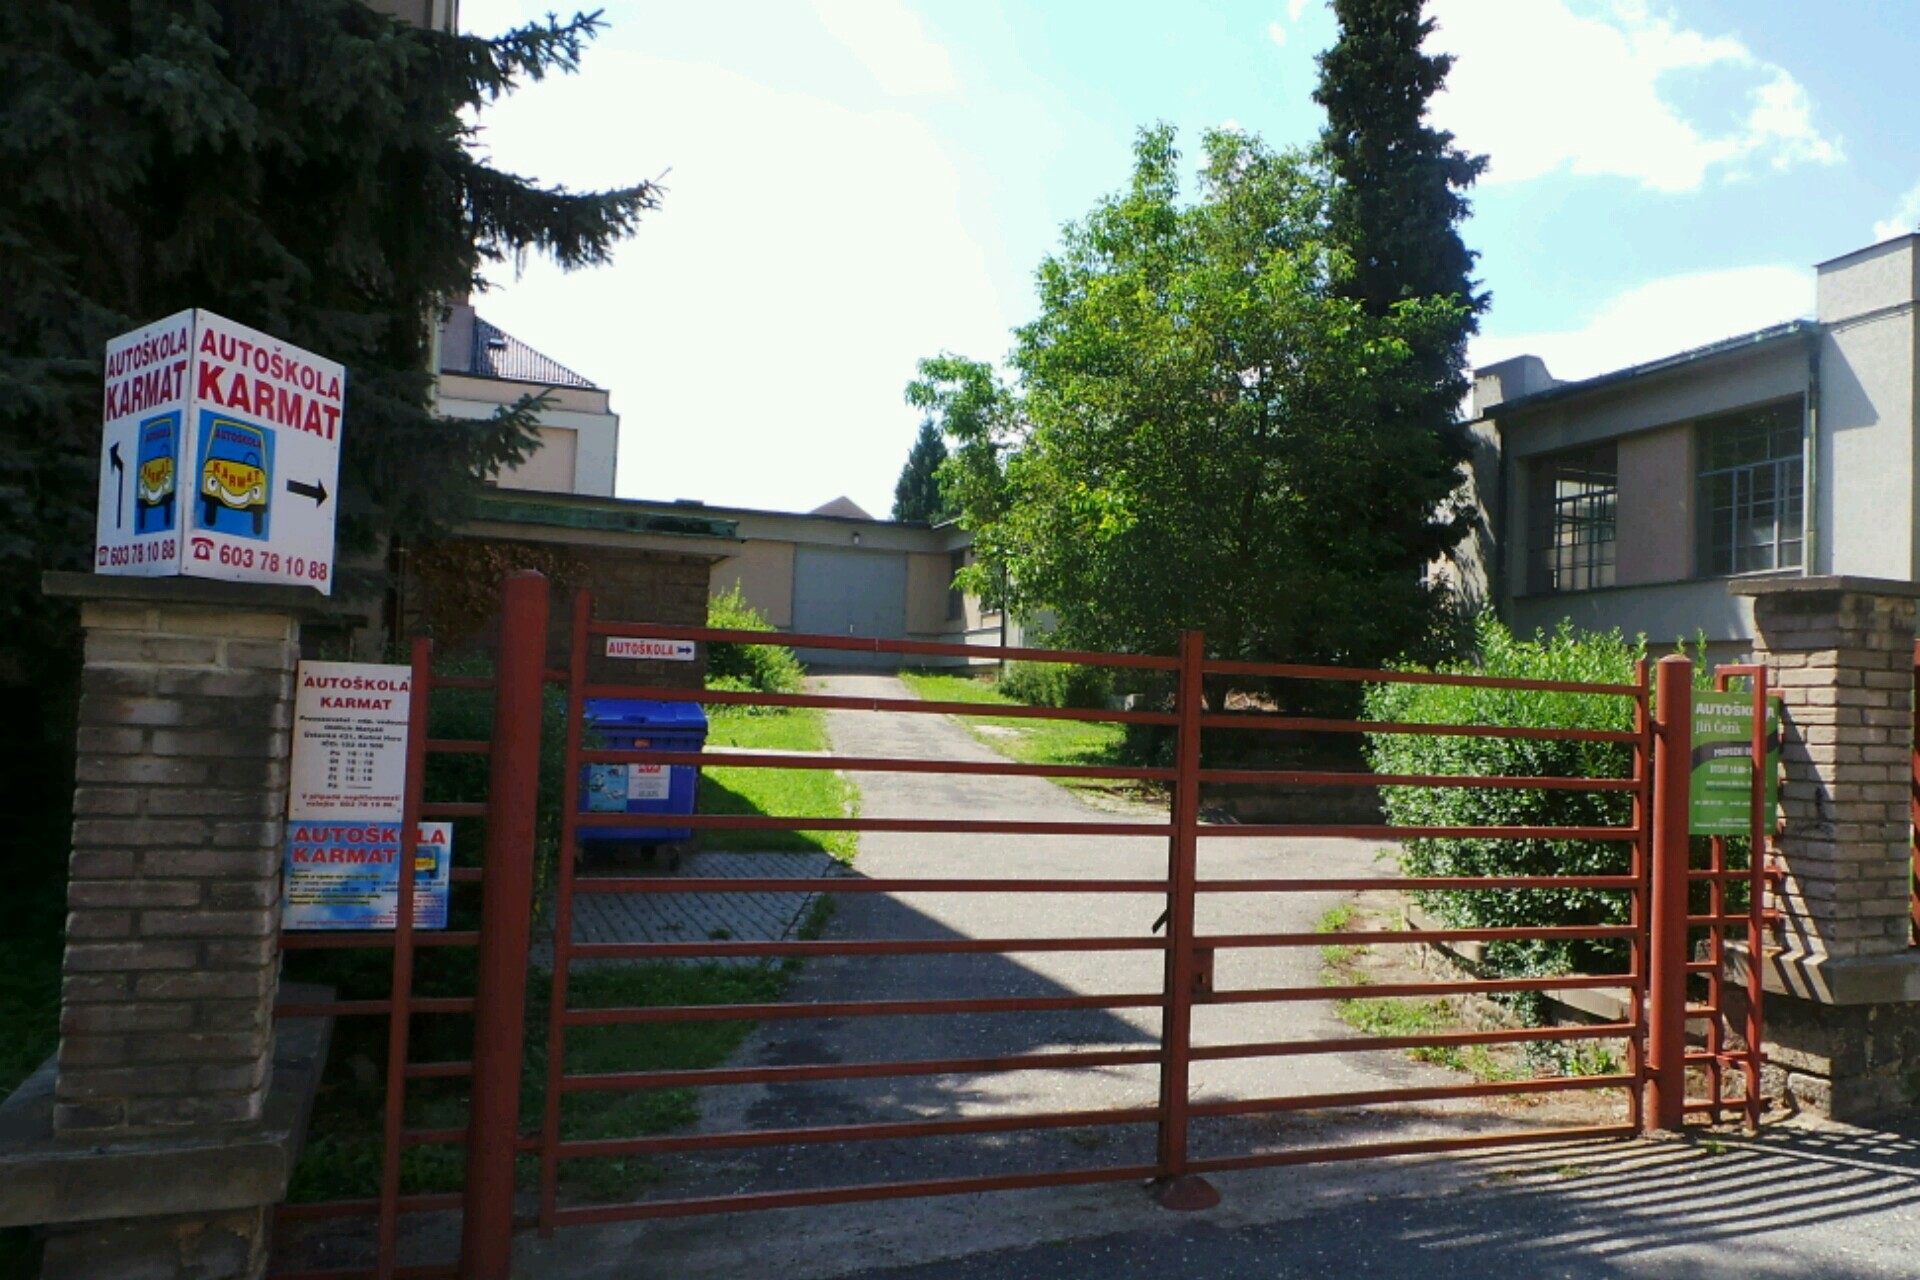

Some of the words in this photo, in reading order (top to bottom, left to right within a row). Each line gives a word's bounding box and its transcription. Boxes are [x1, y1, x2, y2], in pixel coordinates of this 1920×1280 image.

[107, 327, 188, 379] AUTOŠKOLA
[199, 328, 341, 401] AUTOŠKOLA
[106, 360, 187, 421] KARMAT
[197, 360, 341, 440] KARMAT
[213, 461, 260, 488] KARMAT
[110, 545, 129, 566] 603
[131, 543, 144, 564] 78
[147, 541, 159, 562] 10
[161, 539, 175, 560] 88
[219, 544, 254, 568] 603
[259, 551, 280, 572] 78
[285, 556, 305, 577] 10
[308, 560, 328, 580] 88
[609, 640, 675, 655] AUTOŠKOLA
[304, 676, 410, 692] AUTOŠKOLA
[320, 697, 392, 710] KARMAT
[294, 823, 446, 845] AUTOŠKLA
[292, 848, 397, 863] KARMAT
